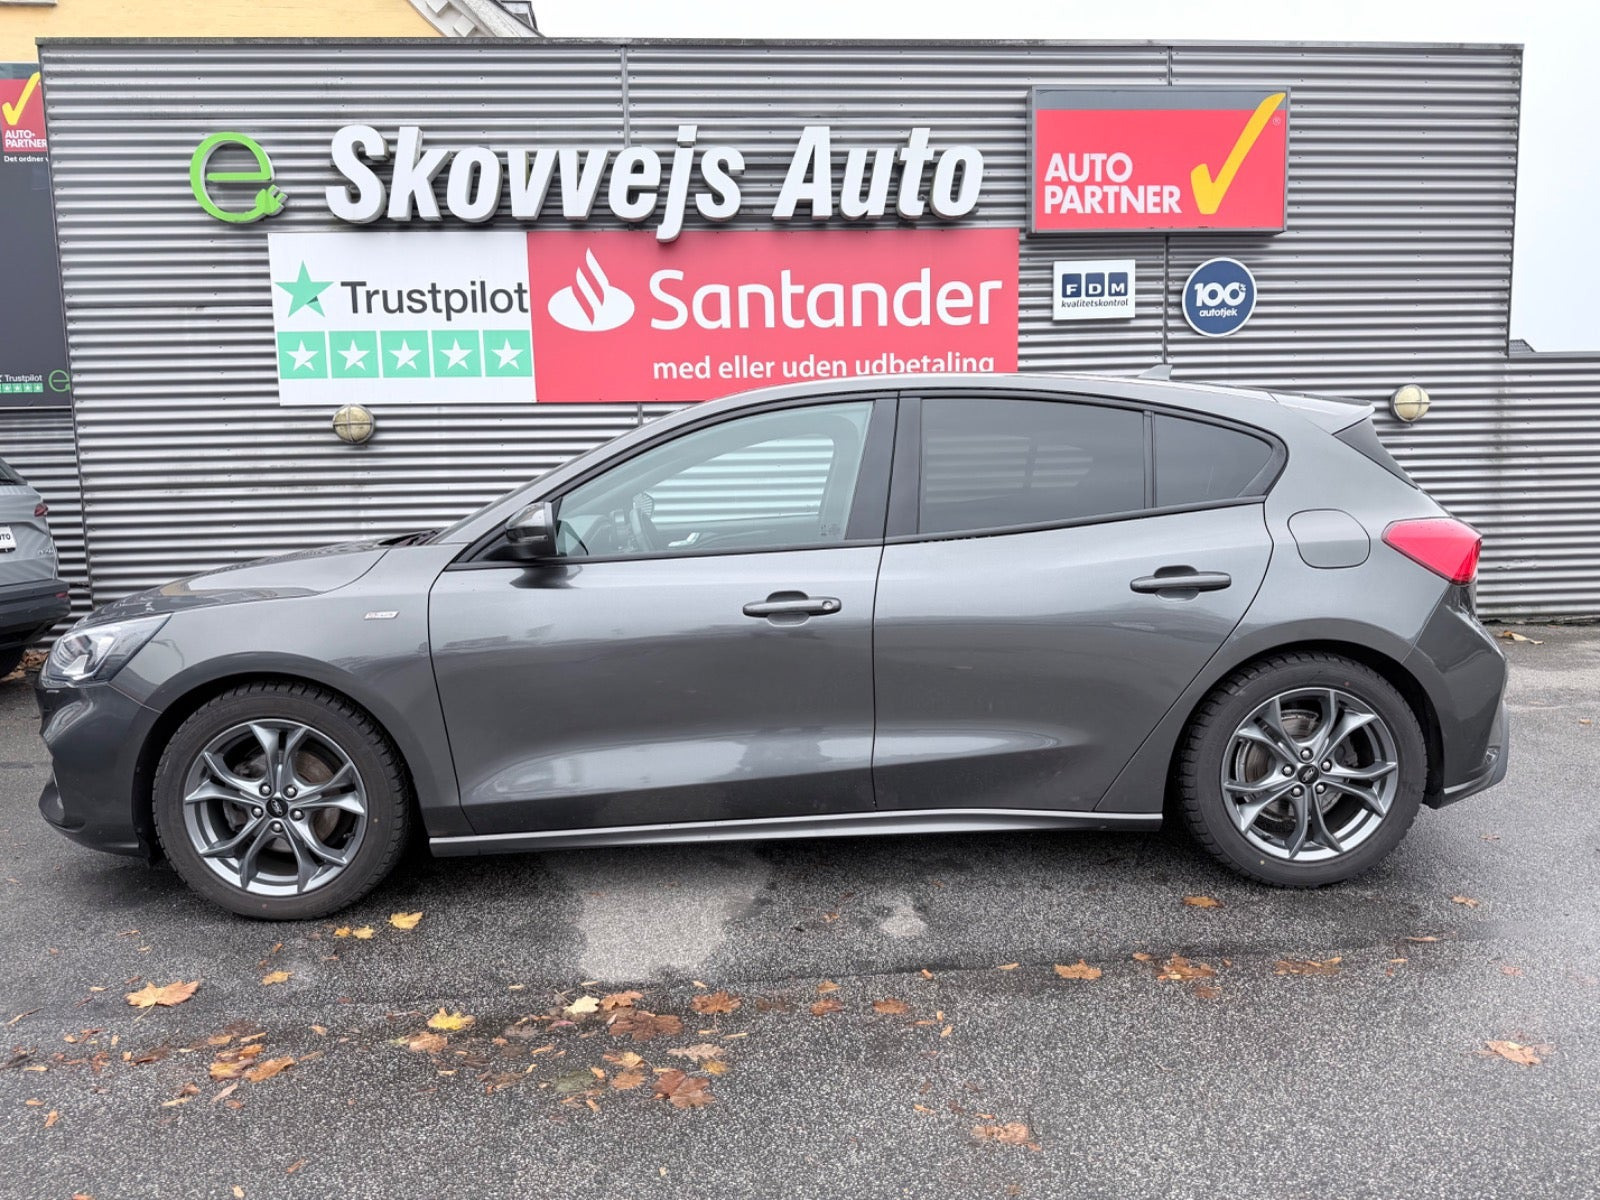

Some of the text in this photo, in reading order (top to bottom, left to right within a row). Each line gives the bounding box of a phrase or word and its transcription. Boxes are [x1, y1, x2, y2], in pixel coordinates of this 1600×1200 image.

[5, 138, 48, 148] PARTNER
[1044, 152, 1134, 183] AUTO
[325, 124, 985, 243] Skovvejs Auto
[1044, 184, 1183, 215] PARTNER
[341, 280, 529, 321] Trustpilot
[648, 267, 1003, 331] Santander
[1061, 298, 1129, 308] kvalitetskontrol
[1065, 281, 1126, 296] FDM
[1199, 307, 1238, 318] autotjek
[4, 374, 43, 383] Trustpilot
[653, 351, 995, 380] med eller uden udbetaling
